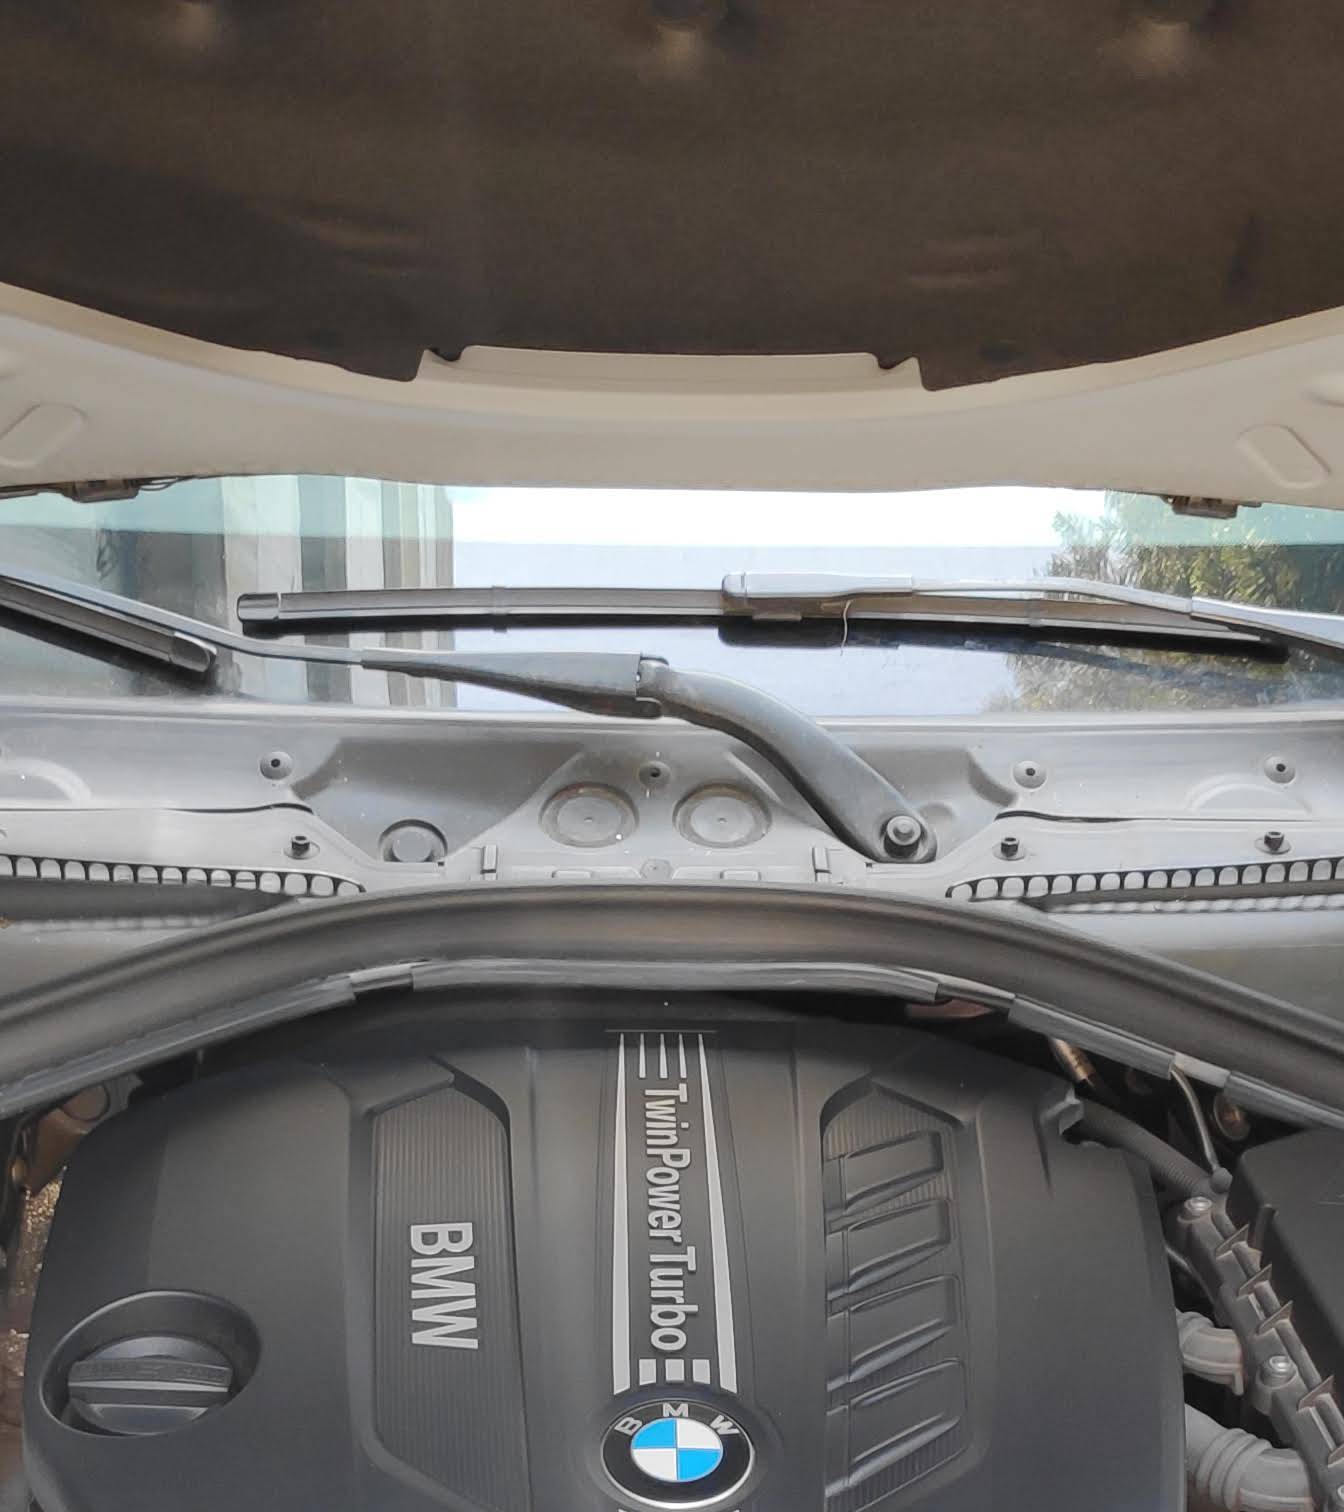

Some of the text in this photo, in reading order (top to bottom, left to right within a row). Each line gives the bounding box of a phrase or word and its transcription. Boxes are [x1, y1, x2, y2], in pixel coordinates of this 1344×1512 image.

[644, 1082, 697, 1352] TwinPower Turbo
[409, 1221, 480, 1351] BMW
[613, 1402, 739, 1437] BMW
